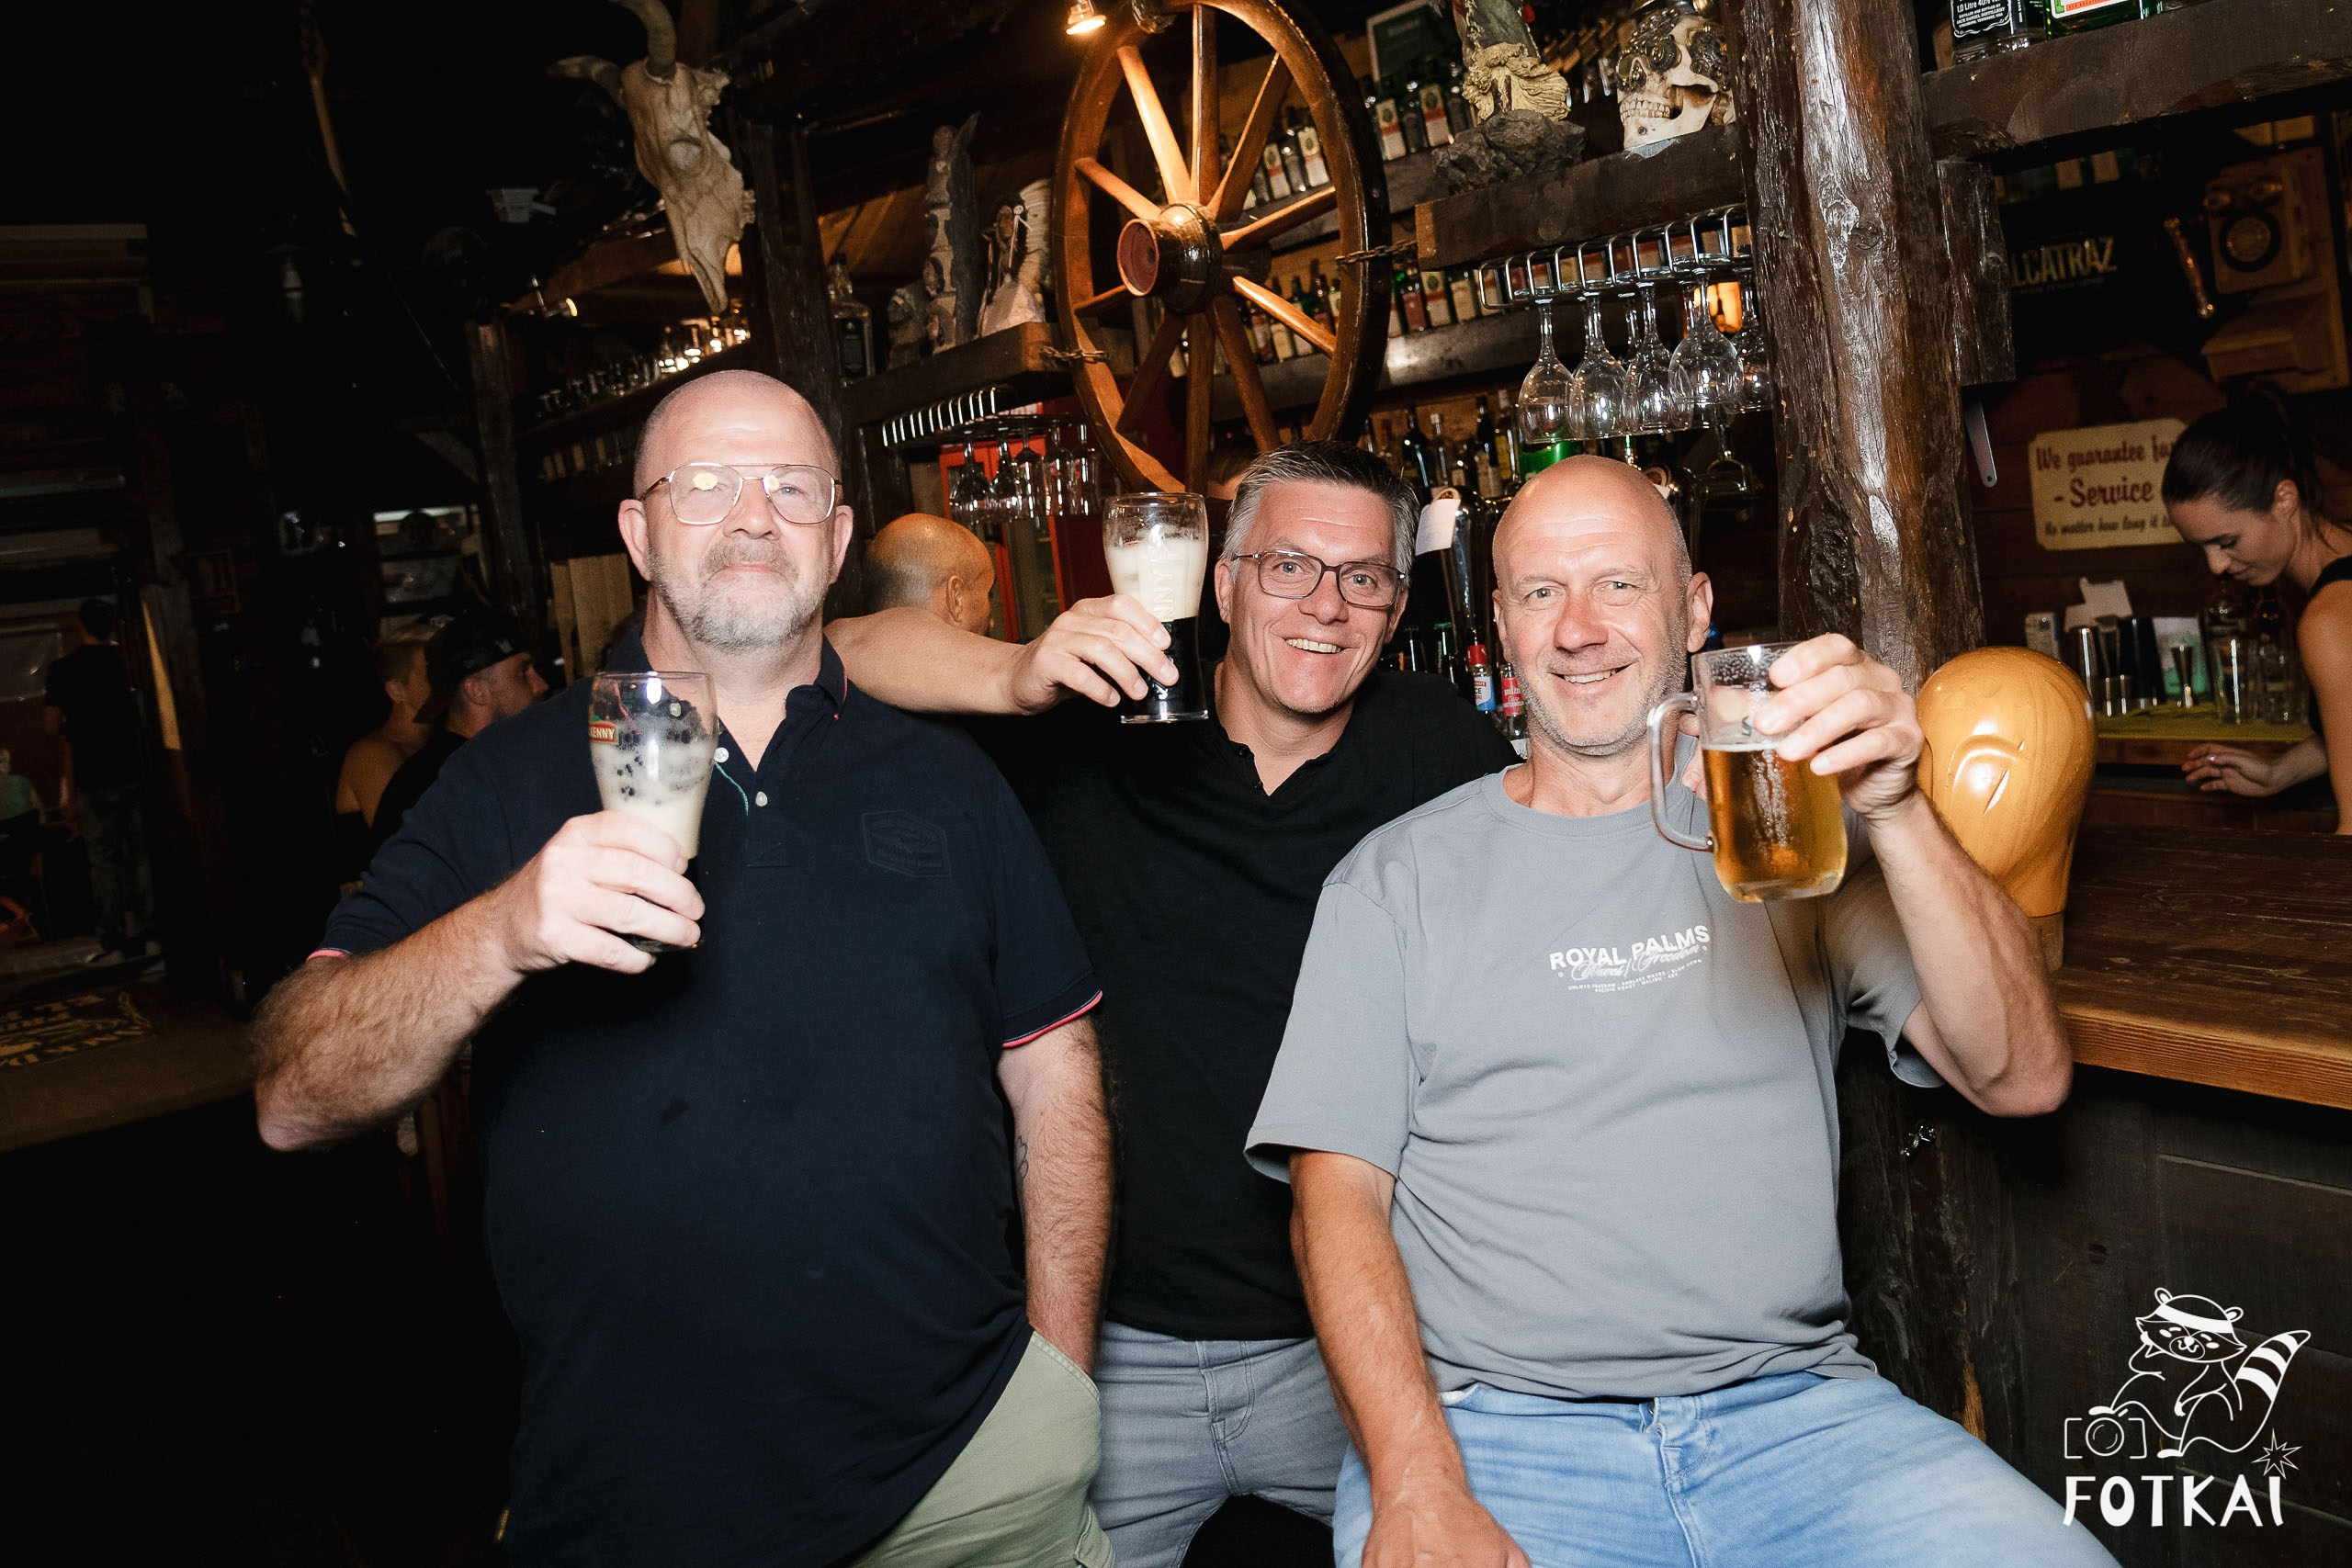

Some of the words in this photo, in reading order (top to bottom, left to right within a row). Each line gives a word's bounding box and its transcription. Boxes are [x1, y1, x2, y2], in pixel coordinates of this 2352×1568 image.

[1964, 2, 1977, 11] Litre
[2010, 234, 2120, 288] LCATRAZ
[2036, 446, 2061, 471] We
[2067, 440, 2146, 473] guarantee
[2069, 476, 2154, 509] Service
[1549, 947, 1628, 971] ROYAL
[1631, 924, 1711, 961] PALMS
